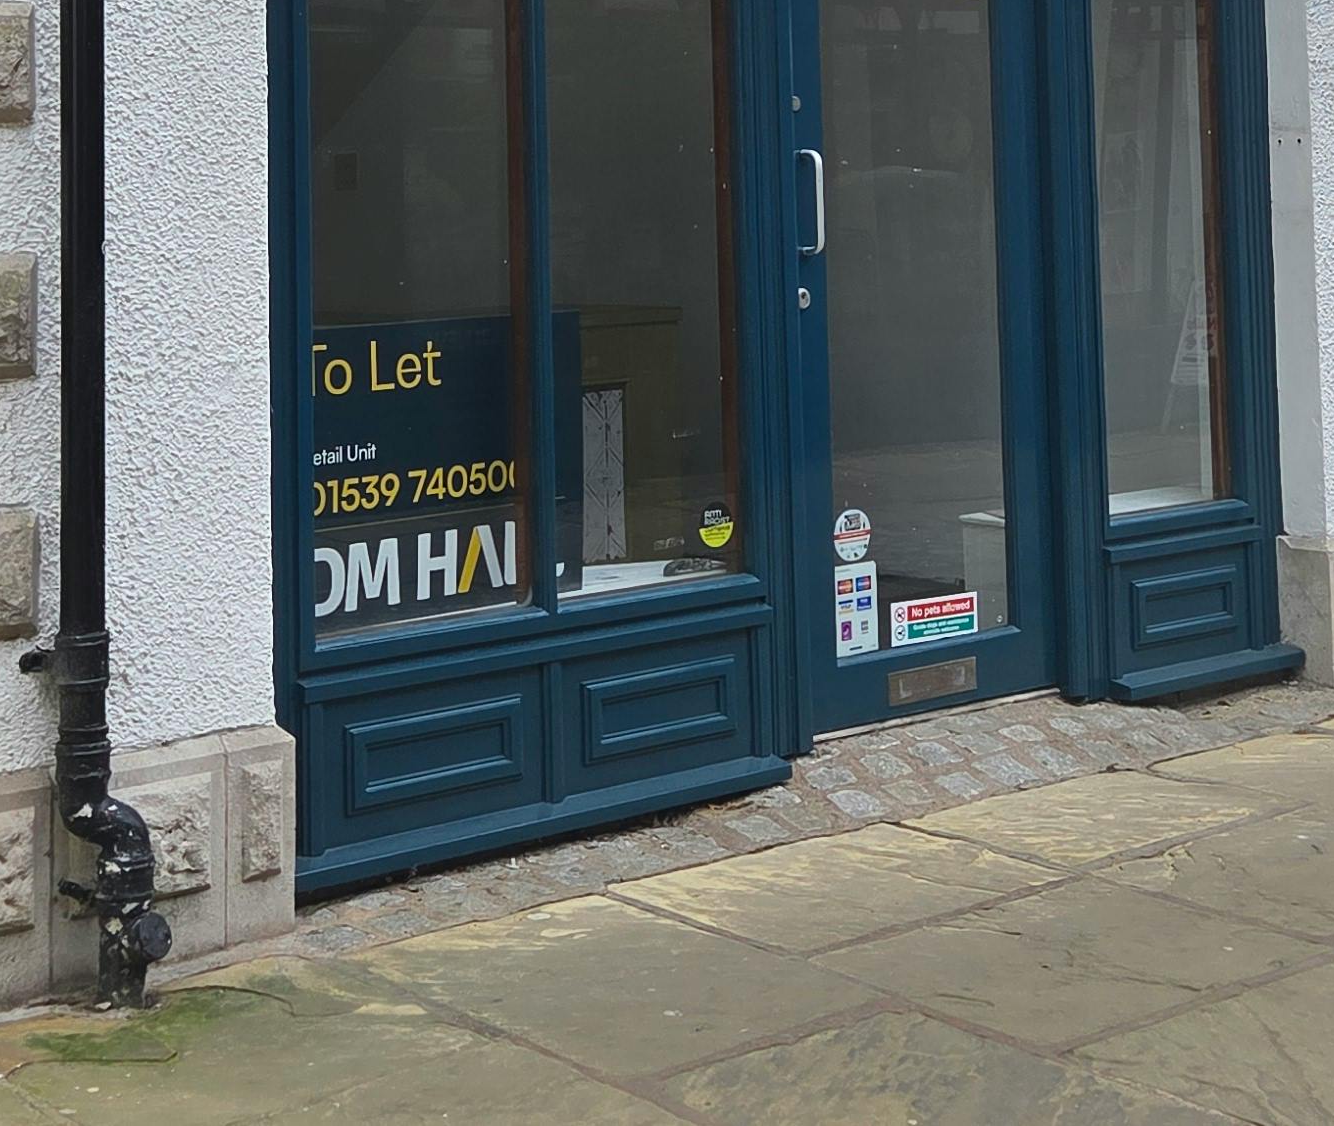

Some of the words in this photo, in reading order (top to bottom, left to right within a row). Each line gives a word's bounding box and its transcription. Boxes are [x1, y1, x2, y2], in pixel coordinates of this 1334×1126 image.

[312, 344, 353, 396] To
[370, 340, 442, 391] Let
[313, 445, 344, 467] etail
[346, 442, 377, 463] Unit
[313, 472, 401, 517] 01539
[314, 537, 402, 618] DM
[911, 607, 923, 618] No
[924, 605, 941, 618] pets
[941, 600, 971, 614] allowed
